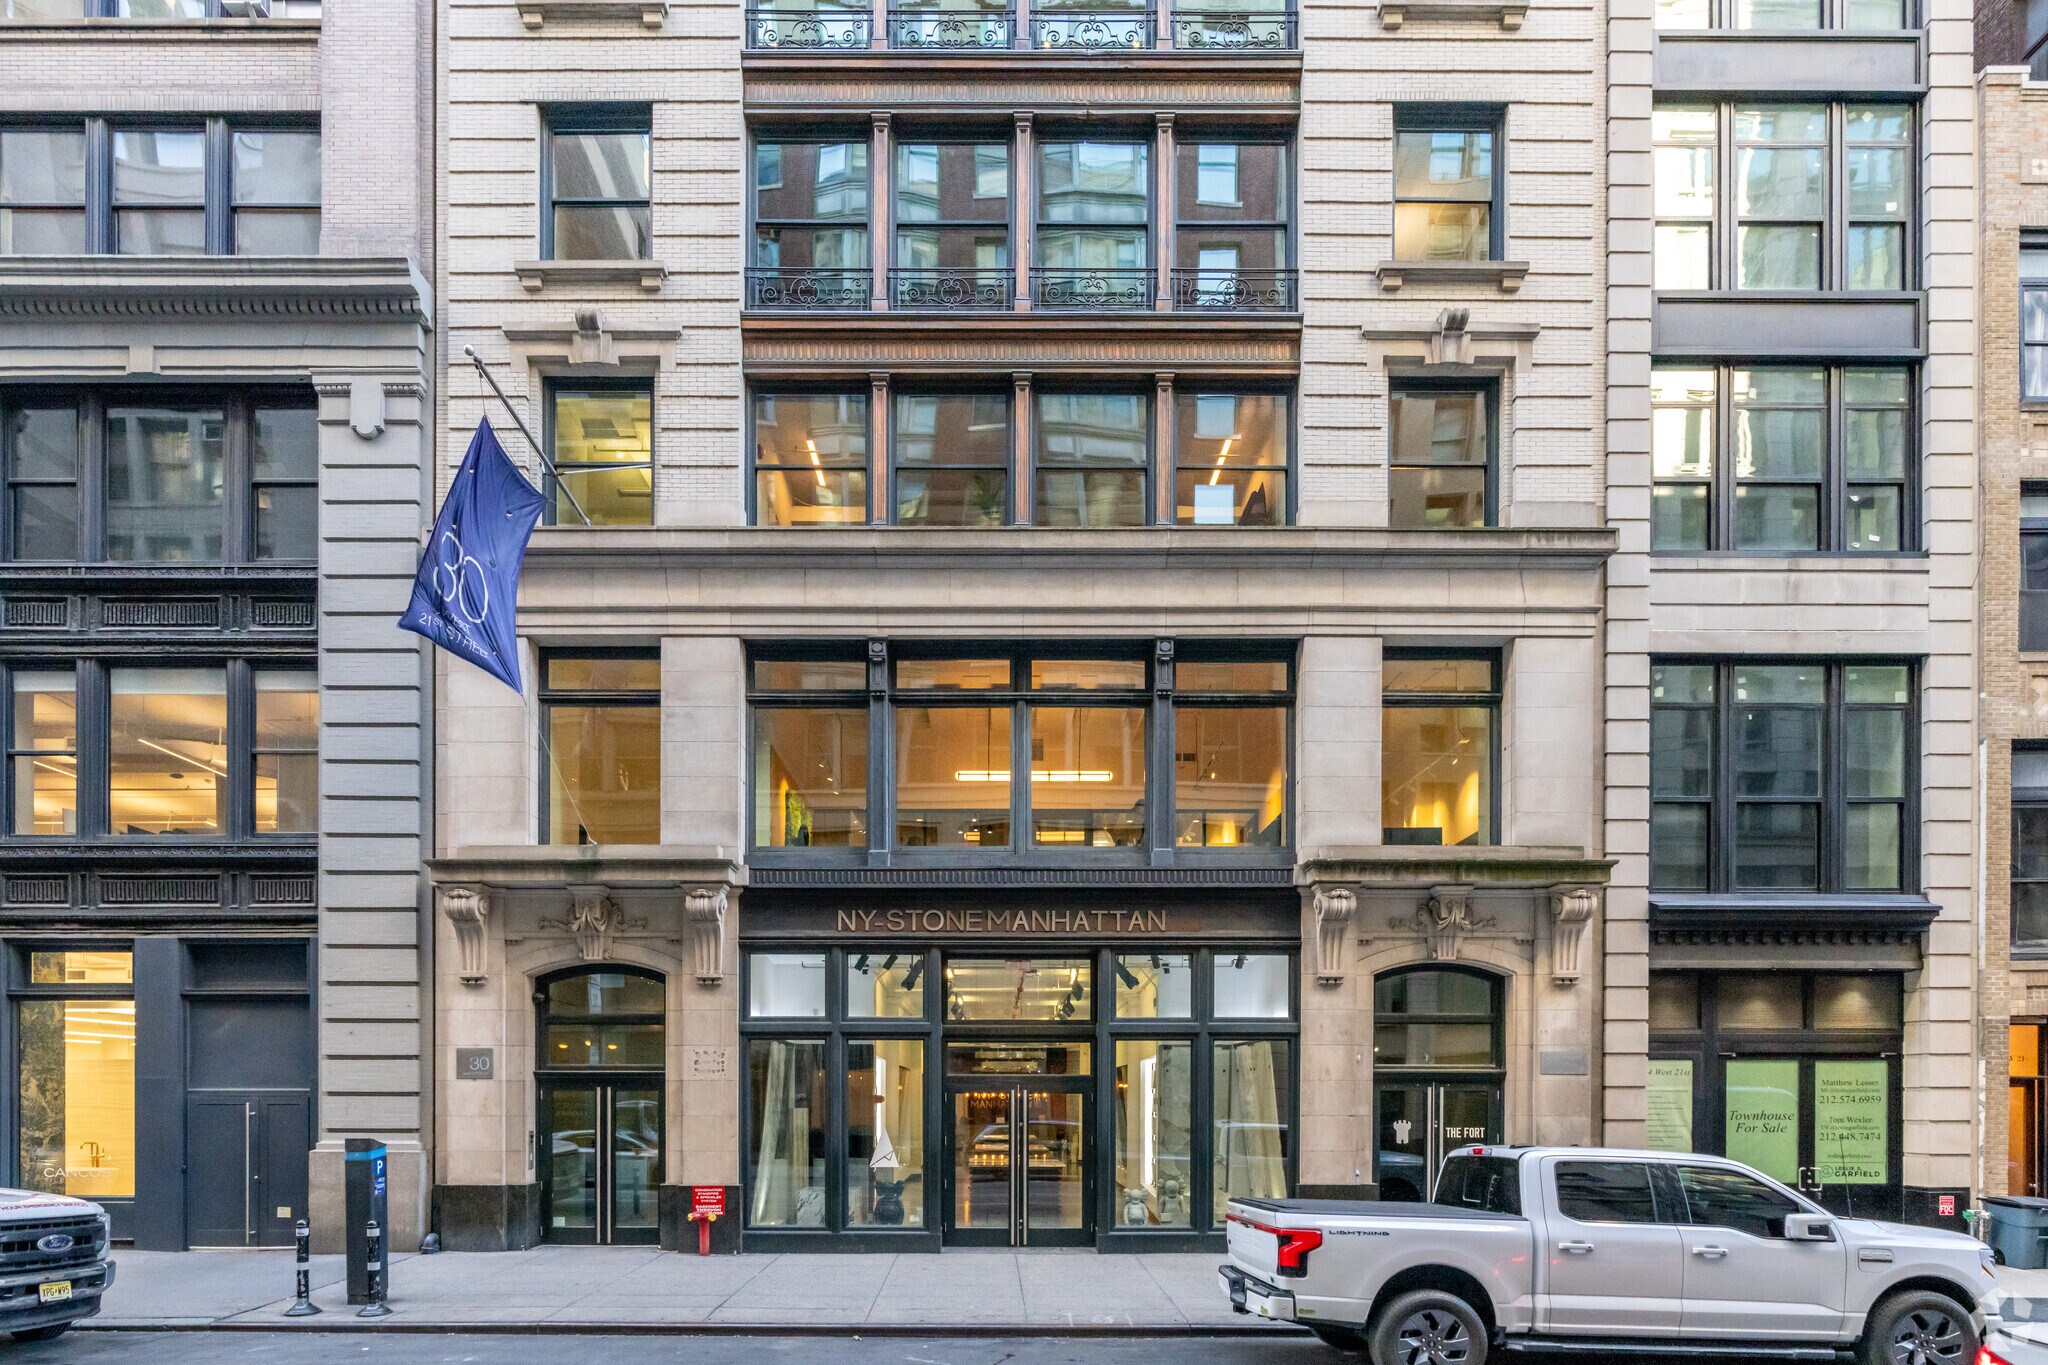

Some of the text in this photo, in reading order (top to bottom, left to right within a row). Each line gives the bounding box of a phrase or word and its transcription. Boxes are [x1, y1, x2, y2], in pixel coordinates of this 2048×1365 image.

[433, 531, 488, 624] 30
[837, 909, 1166, 932] NY-STONE MANHATTAN
[470, 1056, 490, 1070] 30
[1674, 1068, 1691, 1076] 21st
[1819, 1095, 1882, 1104] 212.574.6959
[1730, 1109, 1795, 1121] Townhouse
[1445, 1127, 1485, 1138] THE FORT
[1735, 1122, 1787, 1133] For Sale
[1819, 1132, 1882, 1141] 212.448.7474
[44, 1167, 112, 1178] CANCOS
[377, 1160, 383, 1174] P
